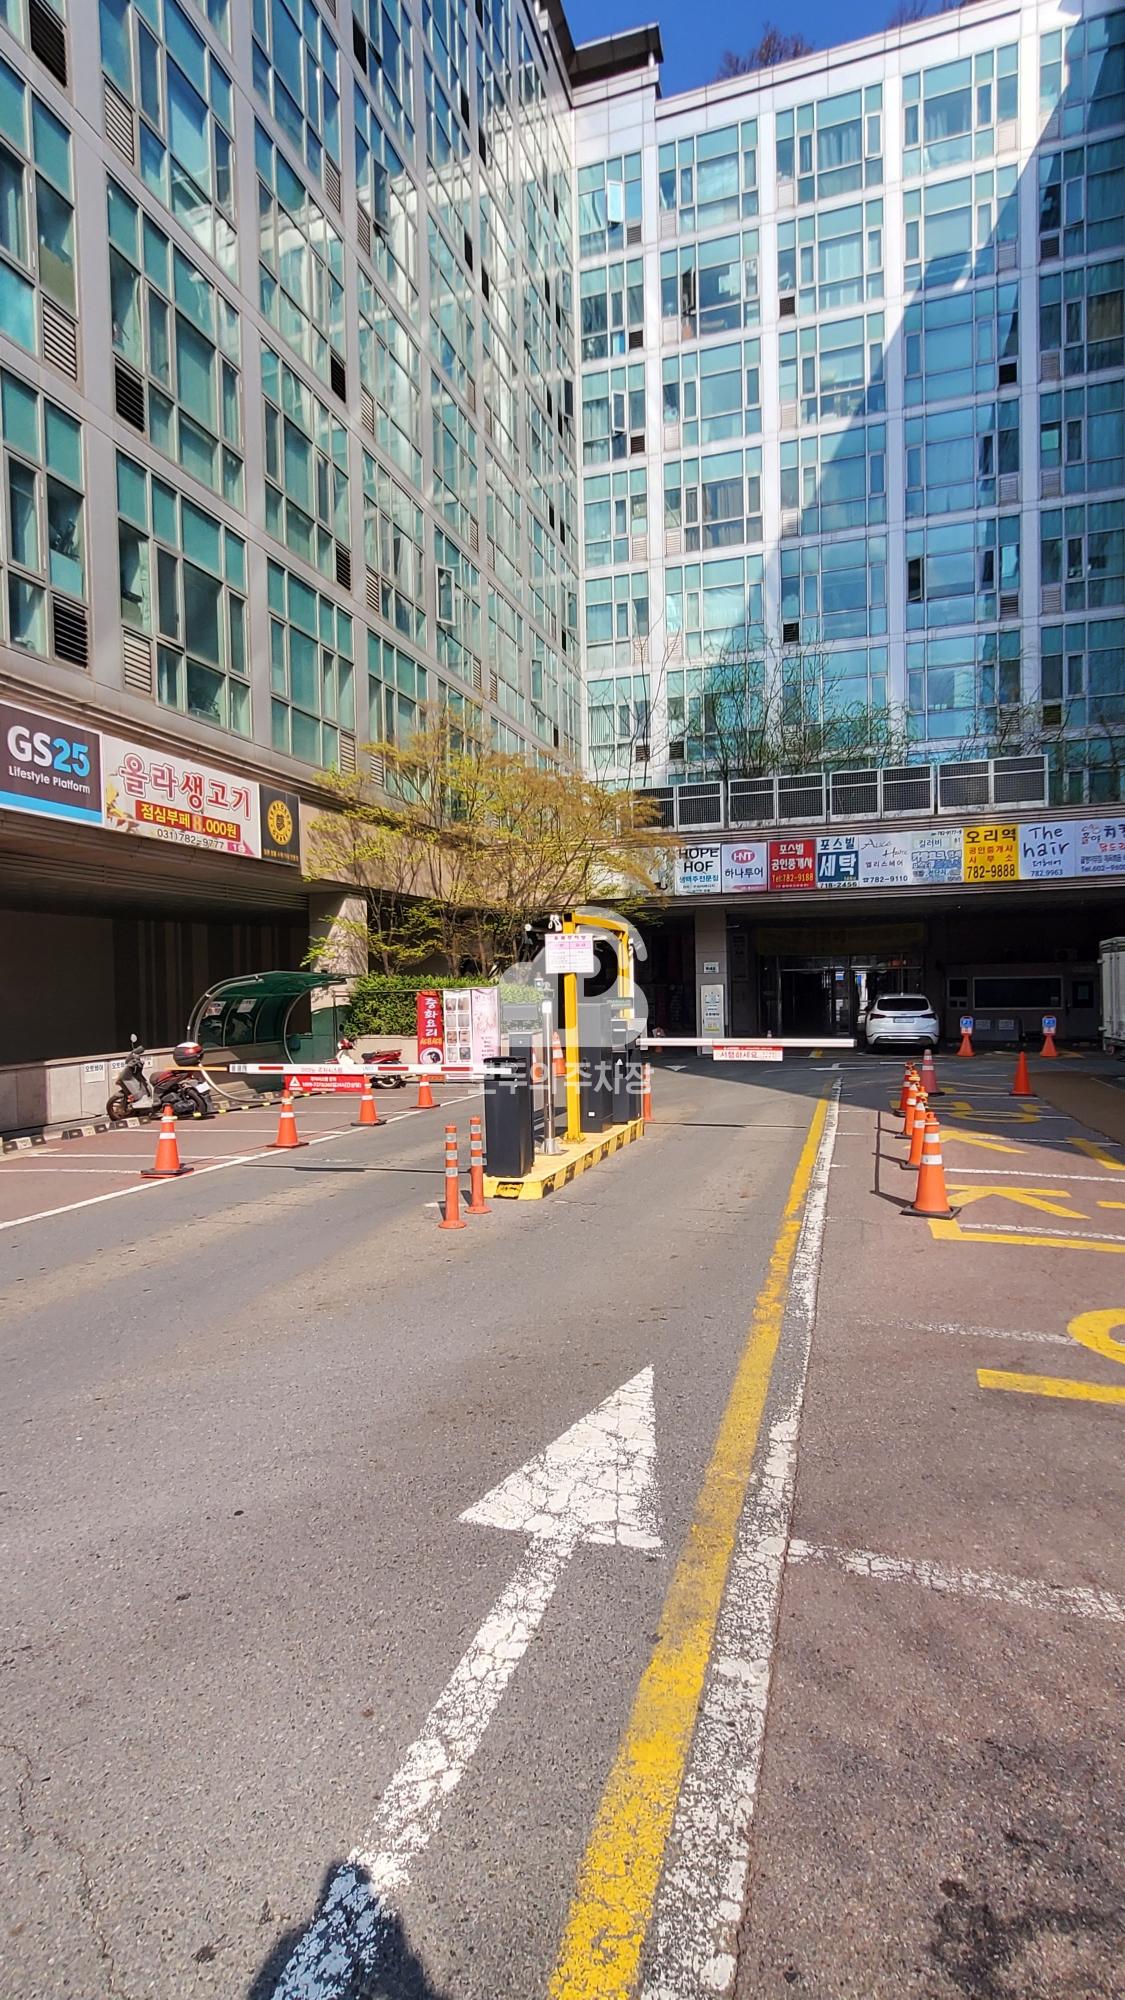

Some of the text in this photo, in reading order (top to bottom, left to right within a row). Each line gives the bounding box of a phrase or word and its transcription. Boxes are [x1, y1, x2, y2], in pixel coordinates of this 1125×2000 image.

[7, 725, 91, 777] GS25
[8, 765, 91, 794] Lifestyle Platform
[118, 753, 252, 820] 올라생고기
[141, 803, 191, 828] 점심부페
[966, 828, 1016, 844] 오리역
[1028, 826, 1063, 840] The
[779, 843, 804, 856] 포스빌
[820, 836, 856, 851] 포스빌
[969, 845, 1014, 855] 공인중개사
[1023, 842, 1070, 858] hair
[678, 847, 719, 859] HOPE
[733, 851, 753, 862] HNT
[684, 860, 714, 872] HOF
[771, 857, 813, 871] 공인중개사
[818, 853, 858, 877] 세탁
[724, 867, 764, 879] 하나투어
[967, 864, 1015, 879] 782-9888
[870, 875, 908, 883] 782-9110
